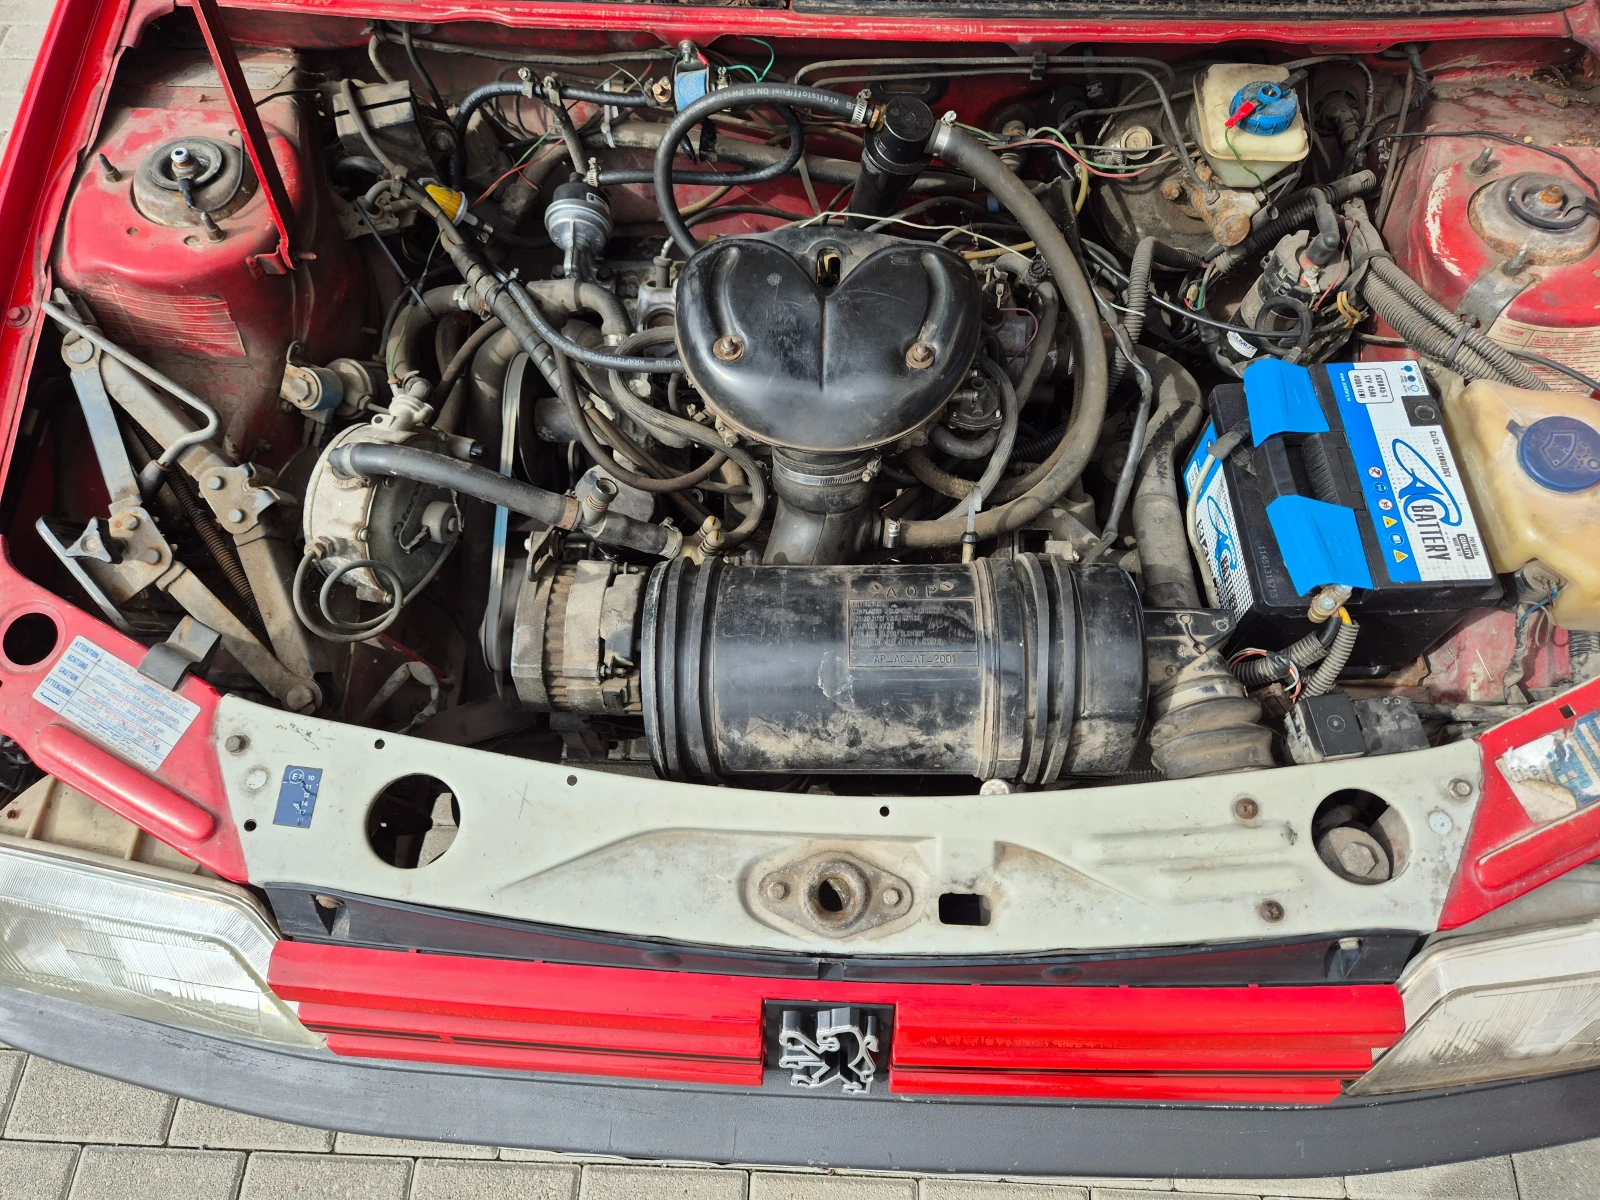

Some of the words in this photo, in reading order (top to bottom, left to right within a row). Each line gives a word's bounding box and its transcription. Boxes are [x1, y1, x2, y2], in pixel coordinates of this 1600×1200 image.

[772, 87, 839, 104] Kraftstoff/Fuel
[582, 350, 645, 366] KRAFTSTOFF/FUEL
[1364, 375, 1373, 383] 12V
[1367, 385, 1377, 398] 45Ah
[1435, 446, 1452, 478] TECHNOLOGY
[1410, 503, 1453, 563] BATTERY
[1459, 535, 1472, 557] QUALITY
[1468, 536, 1480, 555] PREMIUM
[74, 640, 100, 660] ATTENTION
[66, 653, 89, 671] ACHTUNG
[58, 665, 79, 682] CAUTION
[45, 676, 73, 698] ATTENZIONE
